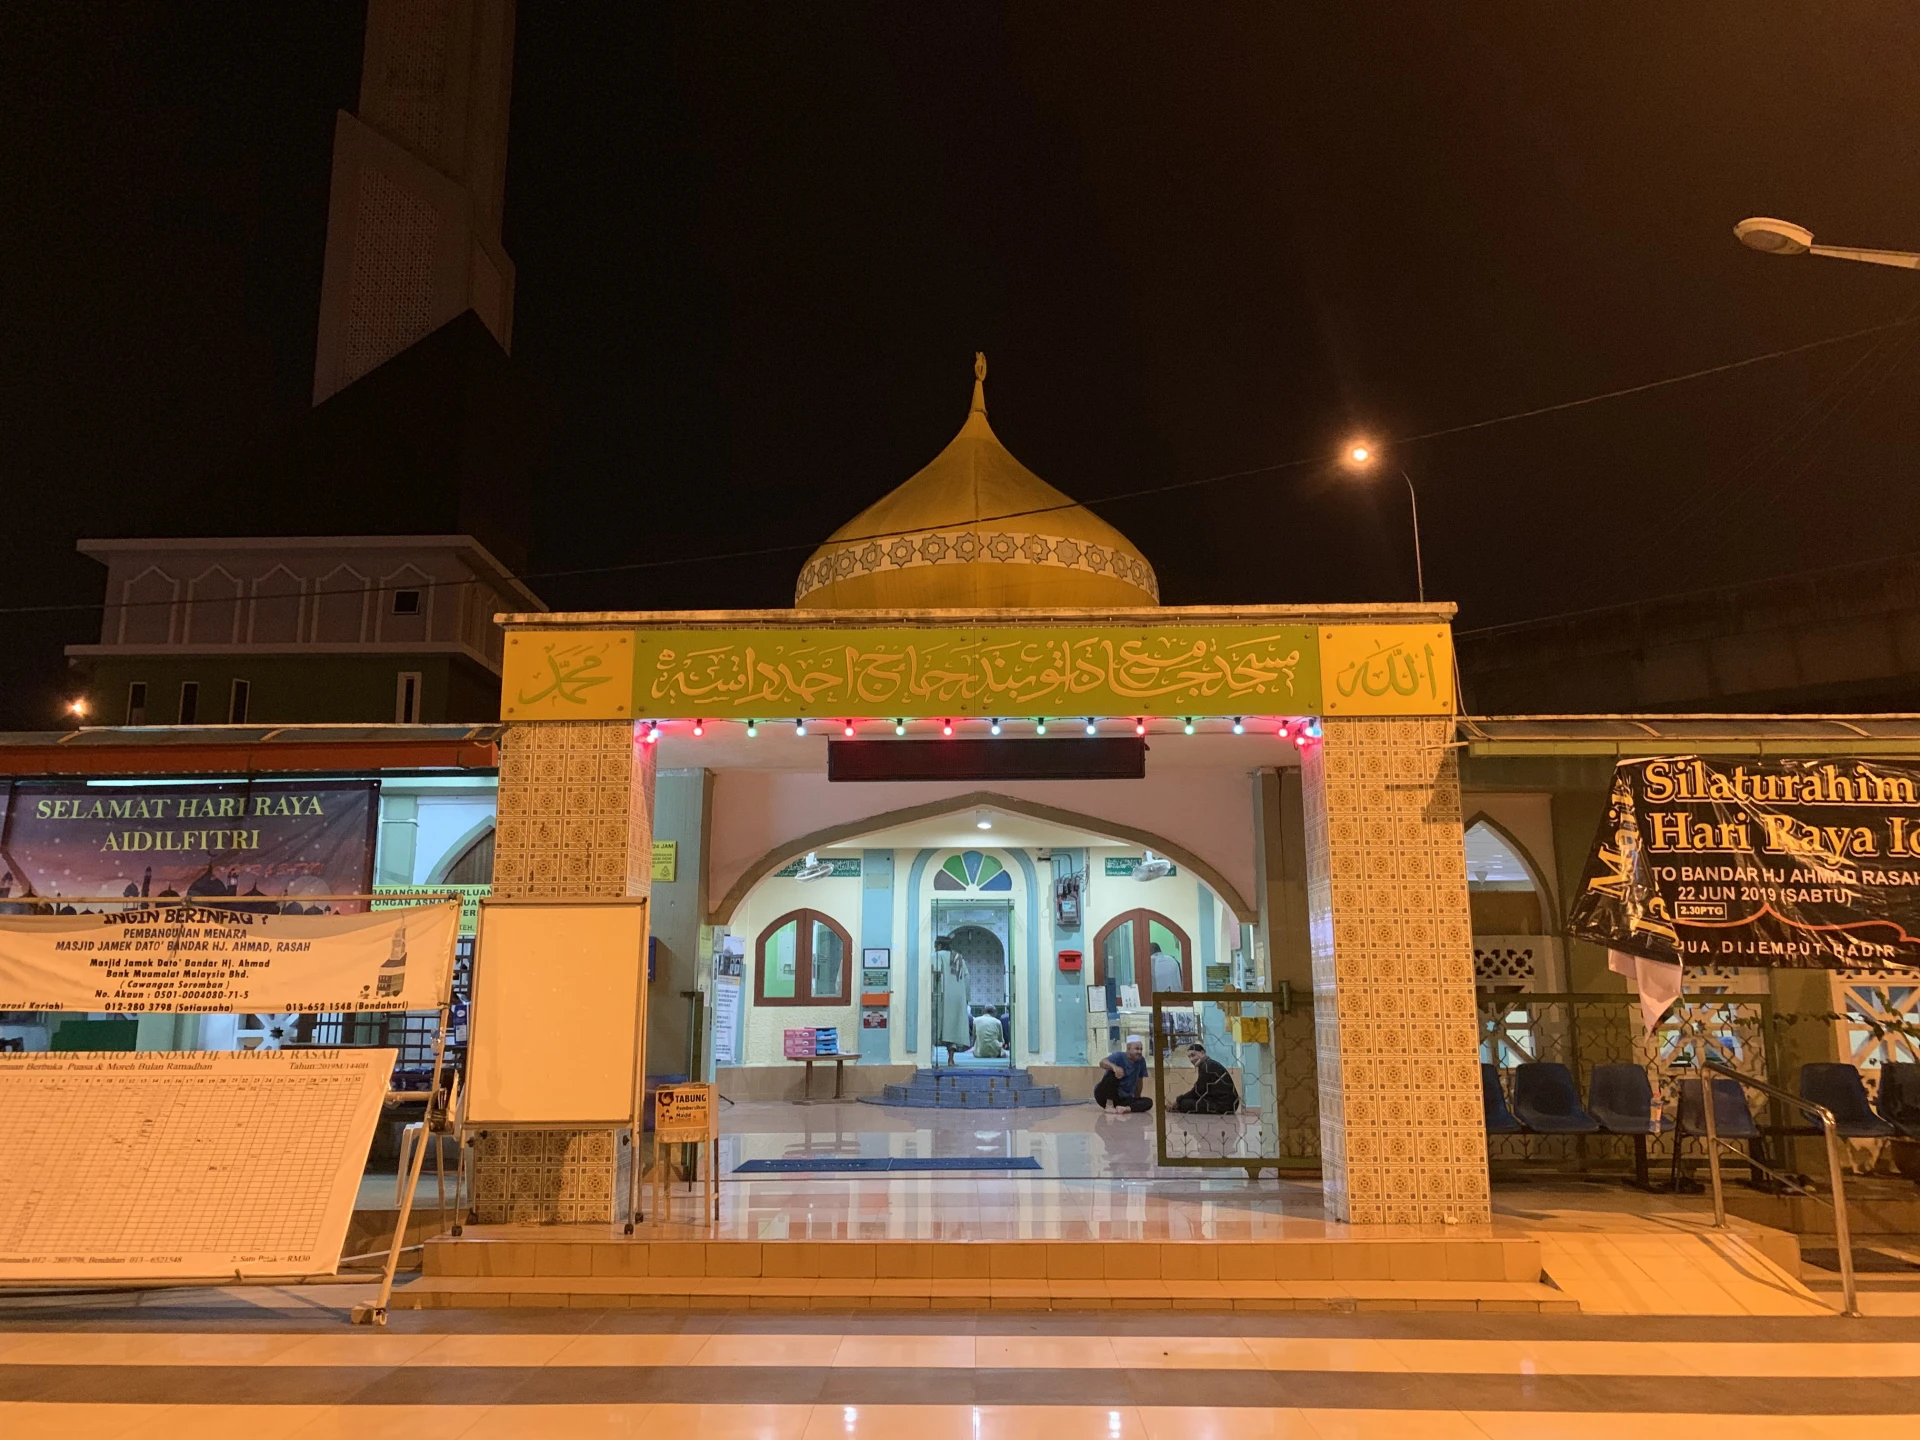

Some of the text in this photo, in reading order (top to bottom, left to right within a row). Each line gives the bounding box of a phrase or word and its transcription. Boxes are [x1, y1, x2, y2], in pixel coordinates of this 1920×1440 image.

[1201, 636, 1299, 698] مسجد
[1337, 640, 1437, 700] الله
[518, 644, 613, 706] محمد
[1643, 760, 1917, 804] Silaturahim
[36, 796, 324, 819] SELAMAT HARI RAYA
[100, 829, 260, 852] AIDILFITRI
[1646, 811, 1753, 852] Hari
[1761, 813, 1878, 868] Raya
[1681, 867, 1759, 882] BANDAR
[1763, 868, 1785, 882] HJ
[1790, 869, 1857, 884] AHMAD
[1678, 886, 1851, 905] 22 JUN 2019 (SABTU)
[103, 910, 160, 924] INGIN
[164, 908, 253, 925] BERINFAQ
[1680, 906, 1723, 916] 2.30PTG
[123, 928, 247, 939] PEMBANGUNAN MENARA
[55, 941, 311, 953] MASJID JAMEK DATO' BANDAR HJ. AHMAD, RASAH
[1722, 941, 1822, 955] DIJEMPUT
[1833, 944, 1895, 957] HADIR
[90, 958, 121, 968] Masjid
[185, 959, 218, 968] Bandar
[222, 960, 235, 970] Hj.
[238, 960, 270, 968] Ahmad
[106, 970, 249, 979] Bank Muamalat Malaysia Bhd.
[127, 980, 174, 989] Cawangan
[95, 990, 110, 998] No.
[114, 990, 144, 998] Akaun
[154, 991, 249, 999] 0501-0004080-71-5
[104, 1003, 145, 1011] 012-280
[148, 1003, 172, 1011] 3798
[286, 1003, 325, 1011] 013-652
[329, 1002, 352, 1010] 1548
[134, 1051, 197, 1061] BANDAR
[290, 1050, 340, 1060] RASAH
[67, 1063, 94, 1071] Puasa
[138, 1063, 164, 1071] Bulan
[166, 1063, 213, 1071] Ramadhan
[675, 1094, 707, 1103] TABUNG
